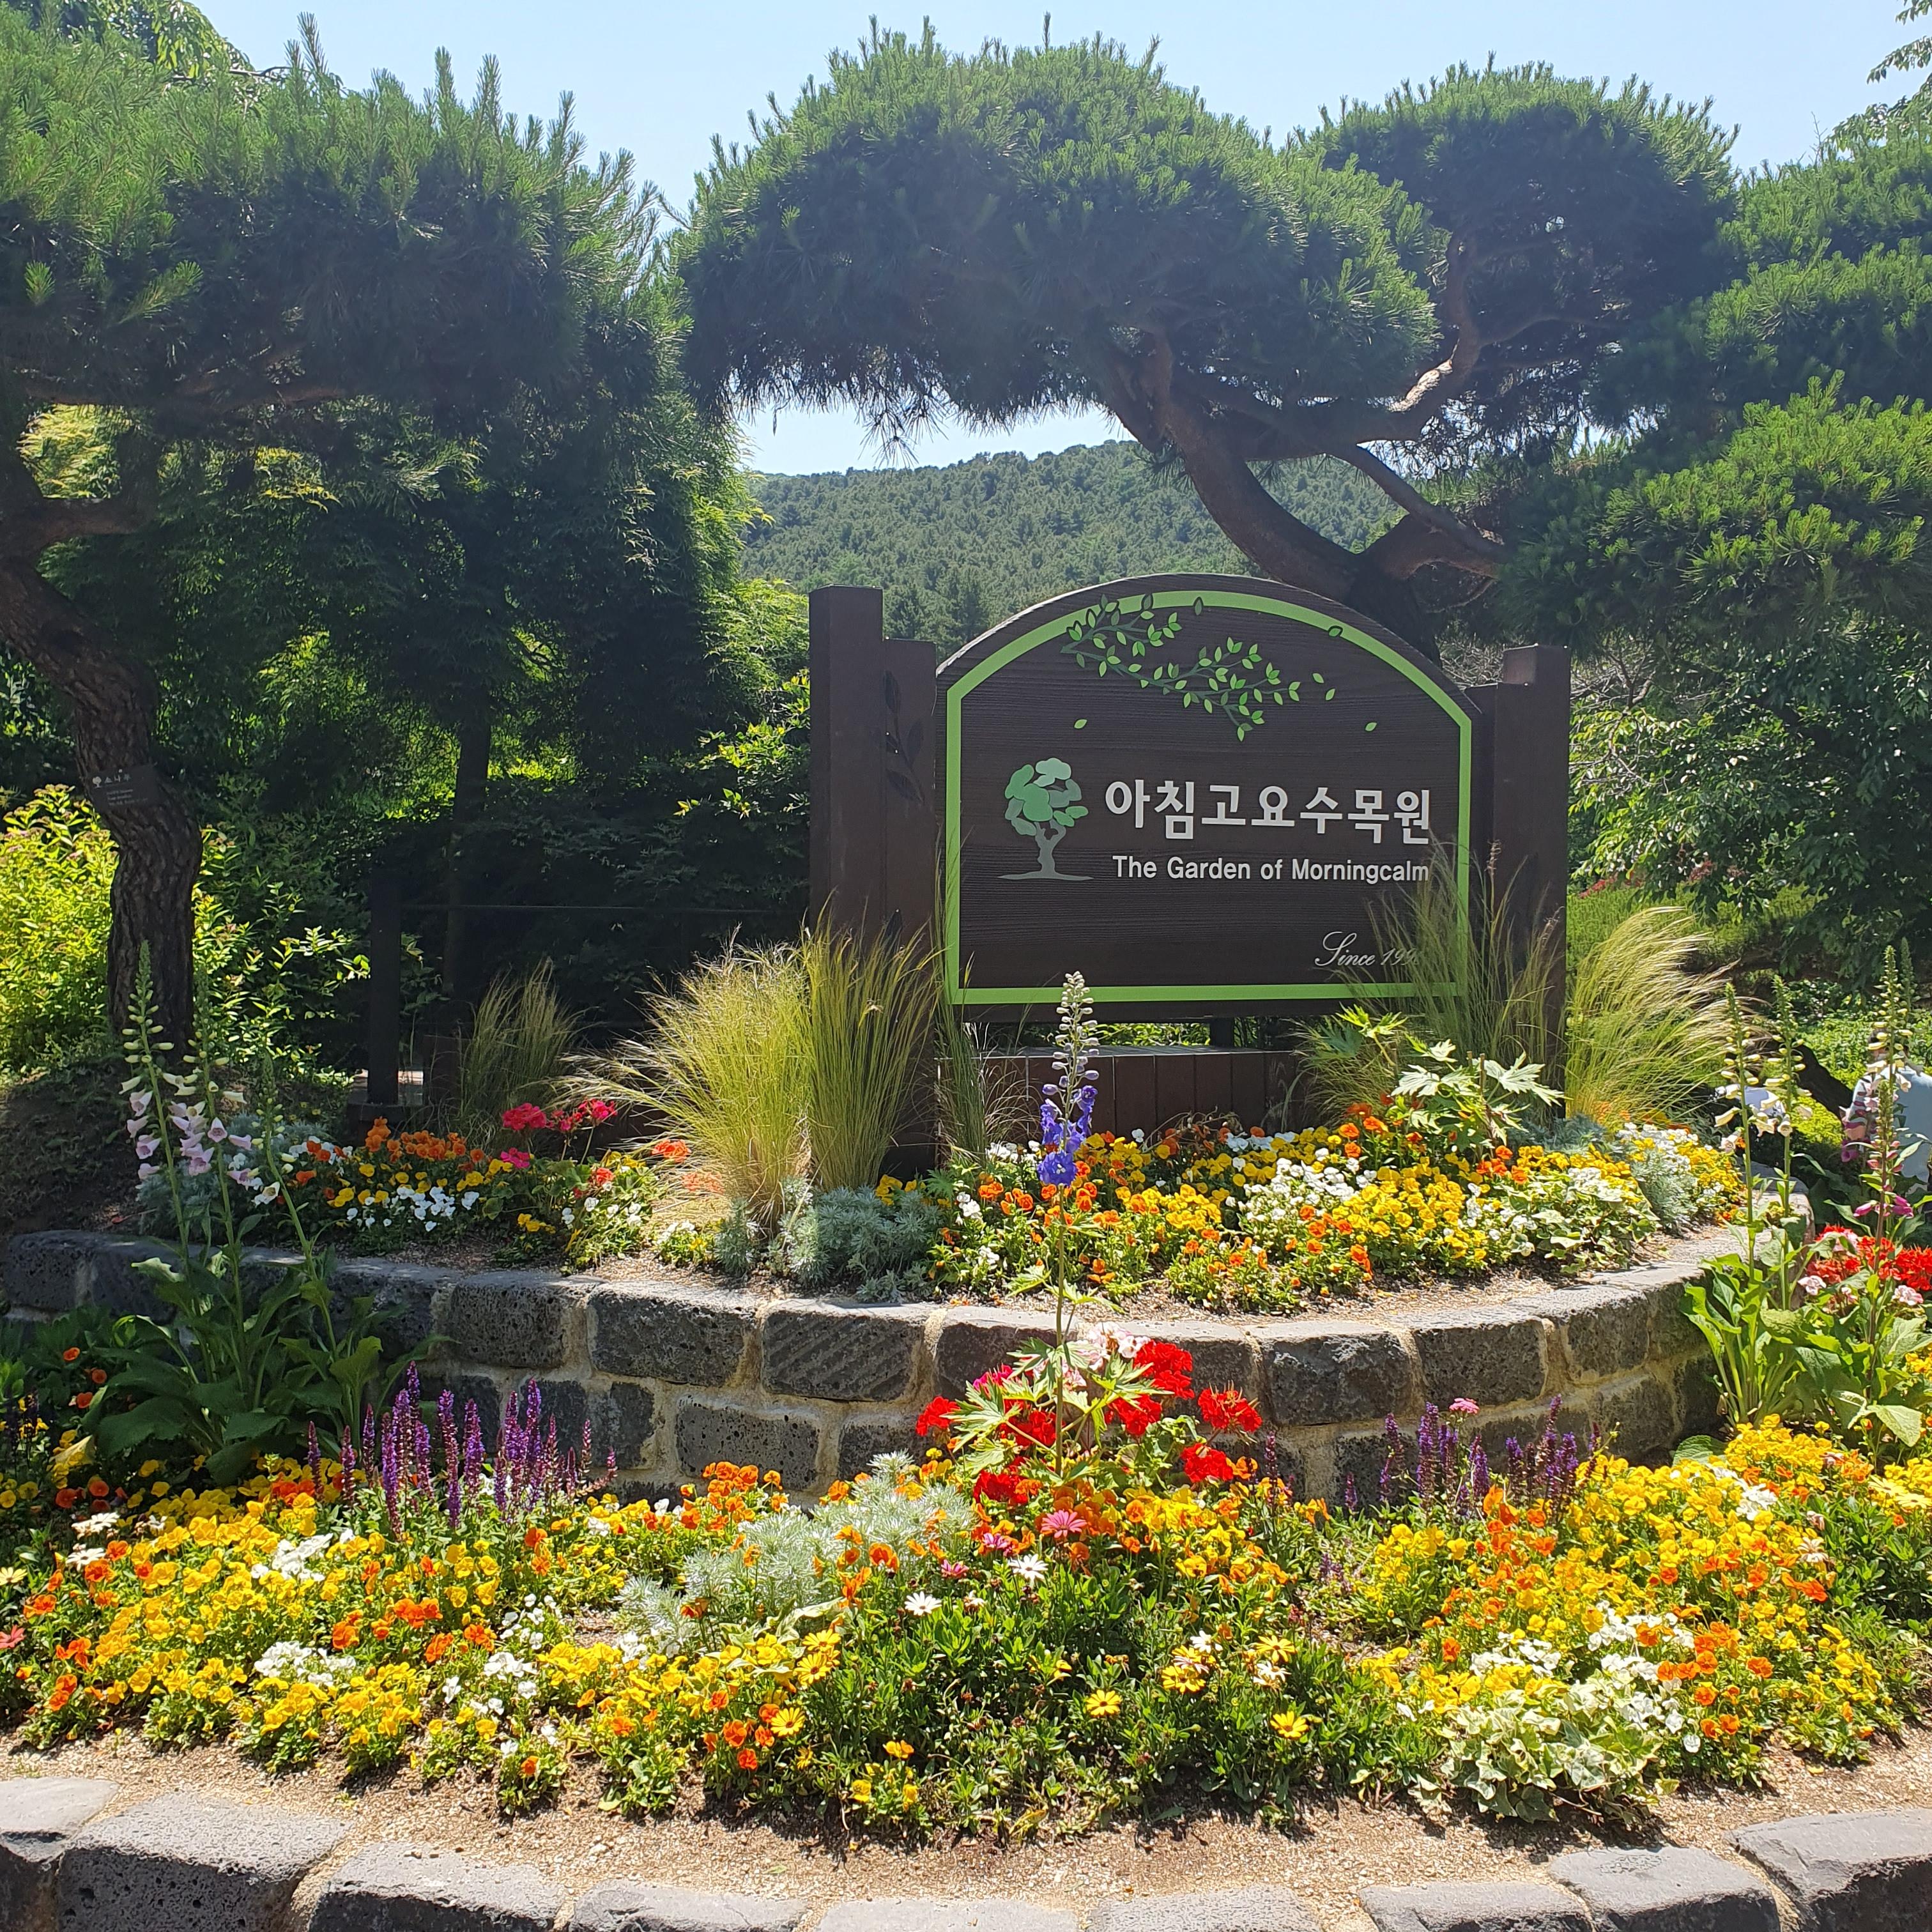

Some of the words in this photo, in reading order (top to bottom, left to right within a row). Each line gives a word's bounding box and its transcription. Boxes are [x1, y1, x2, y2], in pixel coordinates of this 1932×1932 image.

[1105, 779, 1430, 845] 아침고요수목원
[1112, 855, 1157, 878] The
[1167, 856, 1250, 879] Garden
[1261, 859, 1283, 880] of
[1292, 857, 1429, 884] Morningcalm
[1315, 931, 1376, 966] Since
